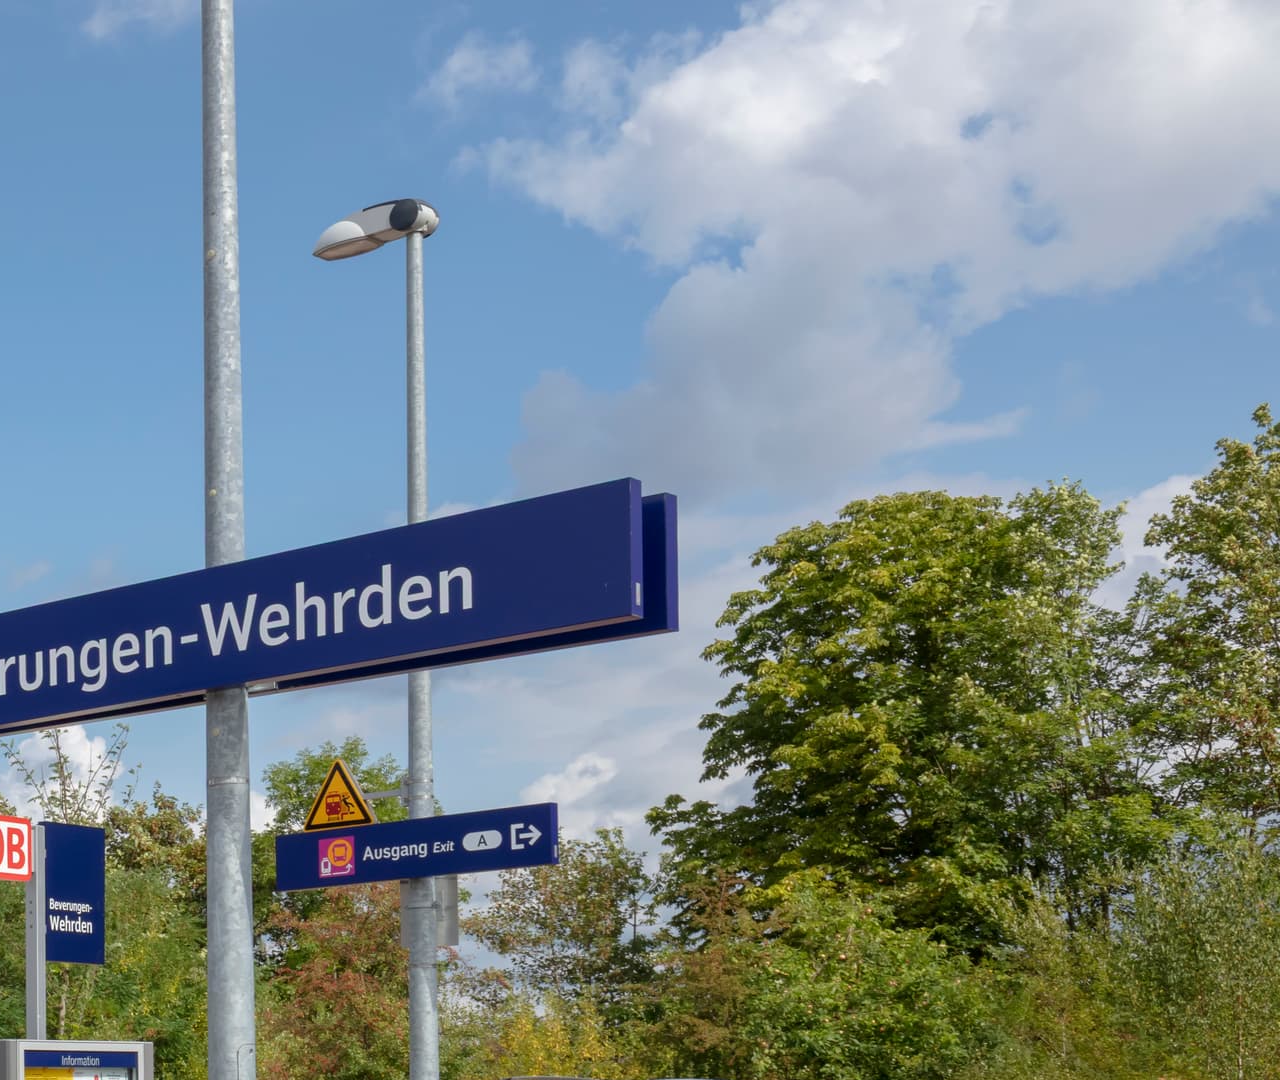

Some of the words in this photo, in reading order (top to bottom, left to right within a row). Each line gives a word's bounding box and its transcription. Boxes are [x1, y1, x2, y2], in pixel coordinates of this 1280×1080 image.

[363, 842, 428, 861] Ausgang
[433, 840, 455, 853] Exit
[477, 834, 487, 847] A
[49, 898, 93, 914] Beverungen-
[49, 914, 93, 934] Wehrden
[61, 1055, 100, 1066] Information
